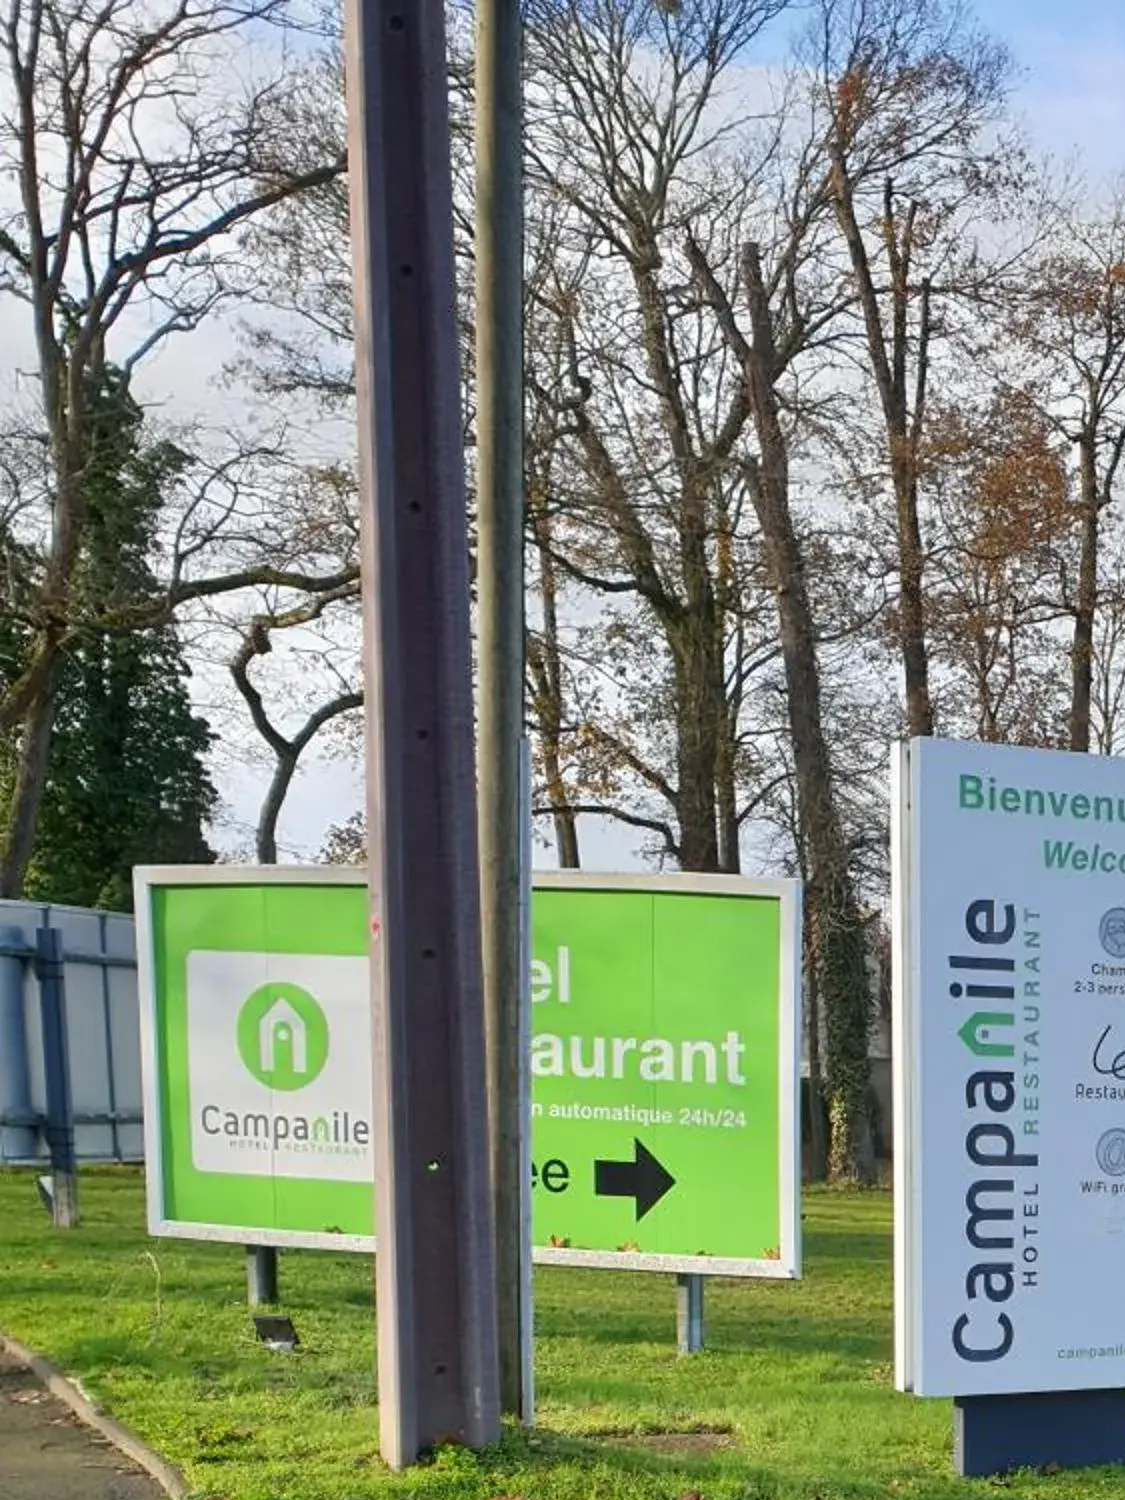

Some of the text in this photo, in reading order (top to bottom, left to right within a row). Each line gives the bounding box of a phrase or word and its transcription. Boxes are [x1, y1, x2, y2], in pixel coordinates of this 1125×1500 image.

[1074, 981, 1095, 993] 2-3
[531, 1031, 747, 1085] aurant
[549, 1103, 673, 1126] automatique
[679, 1107, 747, 1128] 24h/24
[1022, 908, 1041, 1286] HOTEL RESTAURANT
[201, 1105, 369, 1150] Campanile
[948, 899, 1038, 1362] Campanile
